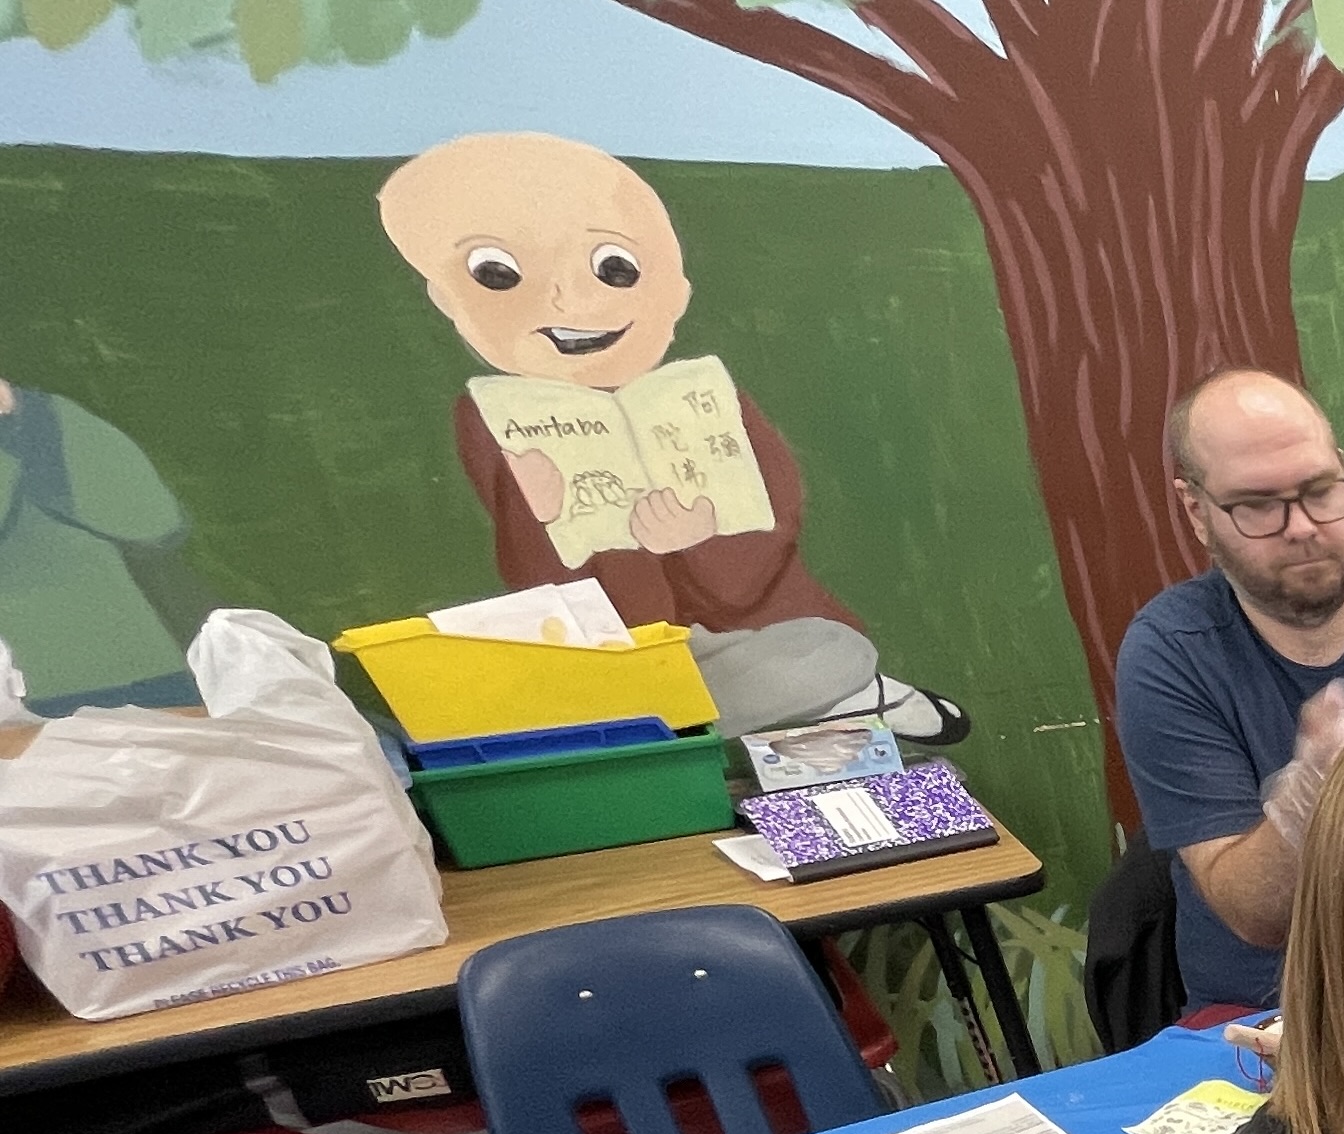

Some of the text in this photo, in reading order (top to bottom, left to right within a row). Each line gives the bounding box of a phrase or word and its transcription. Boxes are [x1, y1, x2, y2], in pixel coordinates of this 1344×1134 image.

[36, 819, 312, 895] THANK YOU
[56, 856, 333, 934] THANK YOU
[79, 891, 352, 972] THANK YOU
